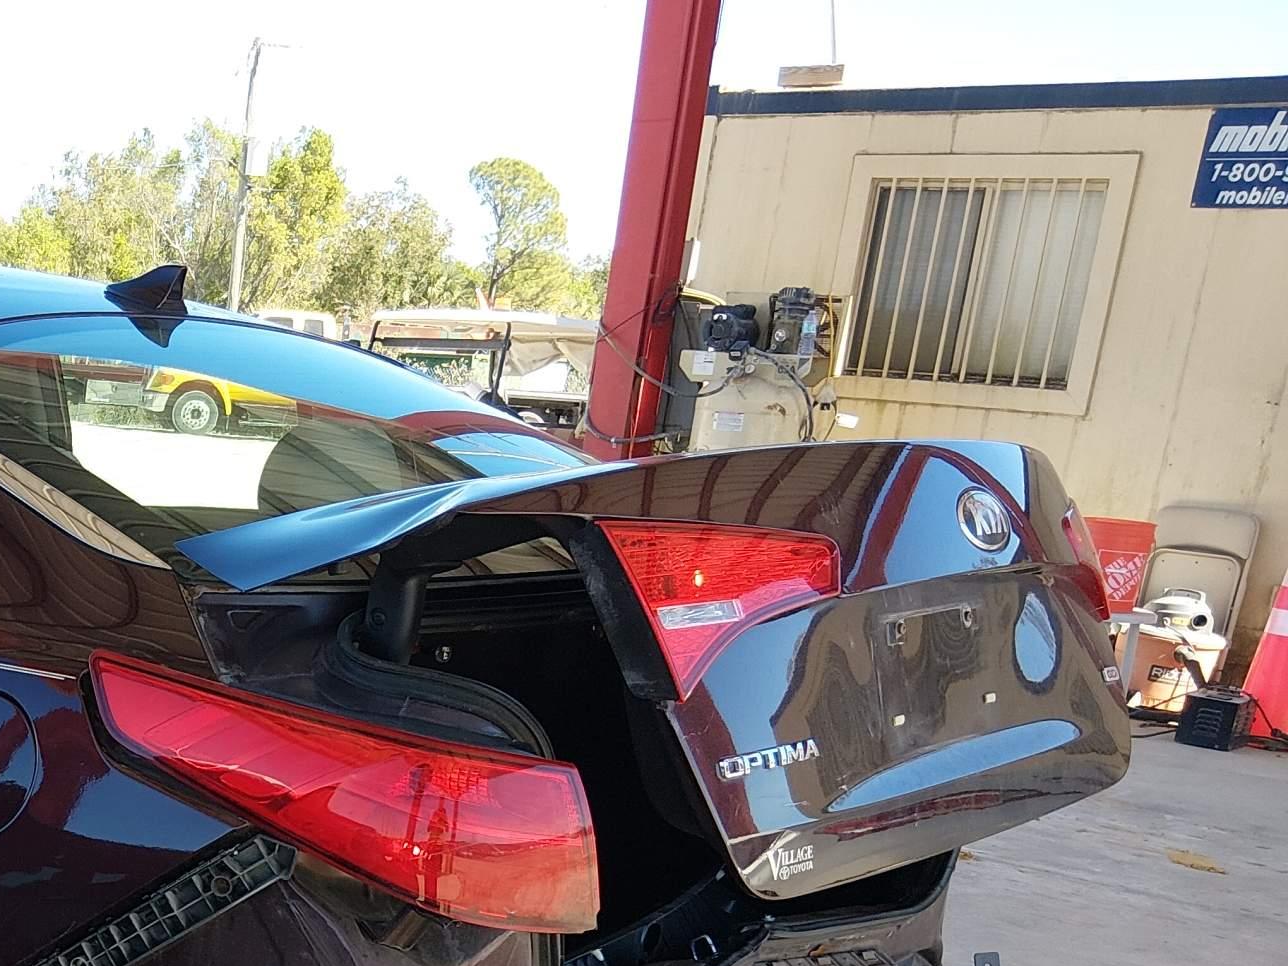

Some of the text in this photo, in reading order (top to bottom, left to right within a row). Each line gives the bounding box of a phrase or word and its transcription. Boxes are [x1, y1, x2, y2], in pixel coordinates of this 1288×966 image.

[1215, 186, 1288, 205] mobile
[717, 739, 820, 780] OPTIMA
[767, 845, 814, 881] VILLAGE
[789, 861, 814, 876] TOYOTA
